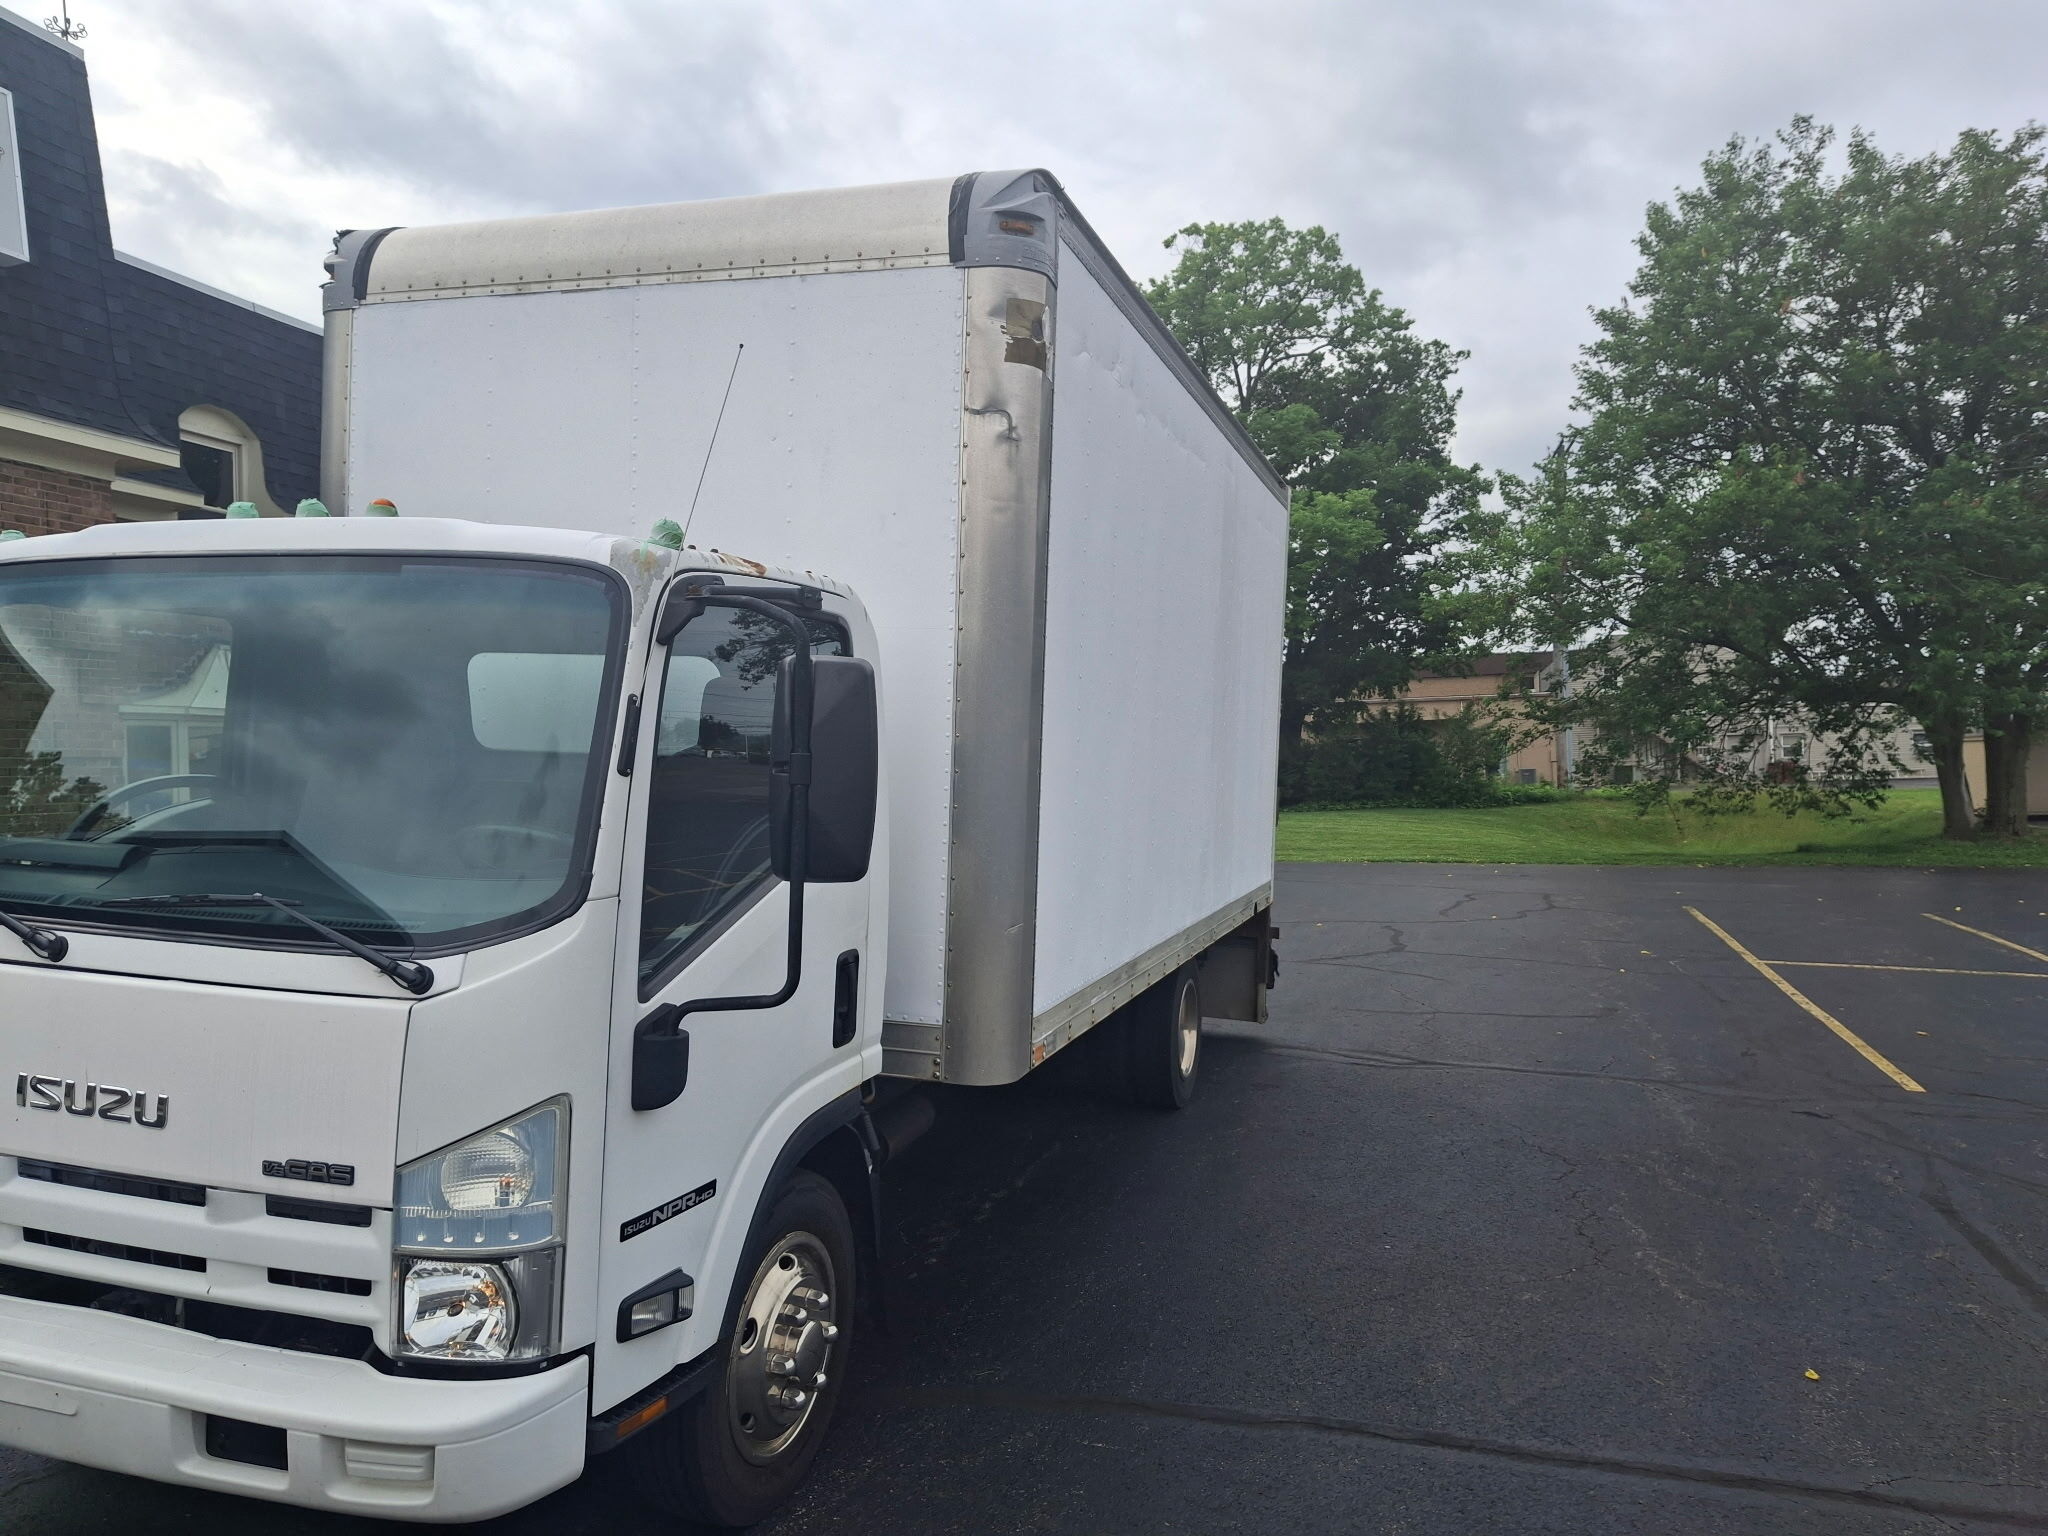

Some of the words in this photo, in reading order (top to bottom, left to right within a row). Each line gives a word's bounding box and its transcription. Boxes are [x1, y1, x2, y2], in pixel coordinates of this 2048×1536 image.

[16, 1071, 169, 1129] ISUZU
[624, 1216, 651, 1236] ISUZU
[651, 1192, 697, 1225] NPR
